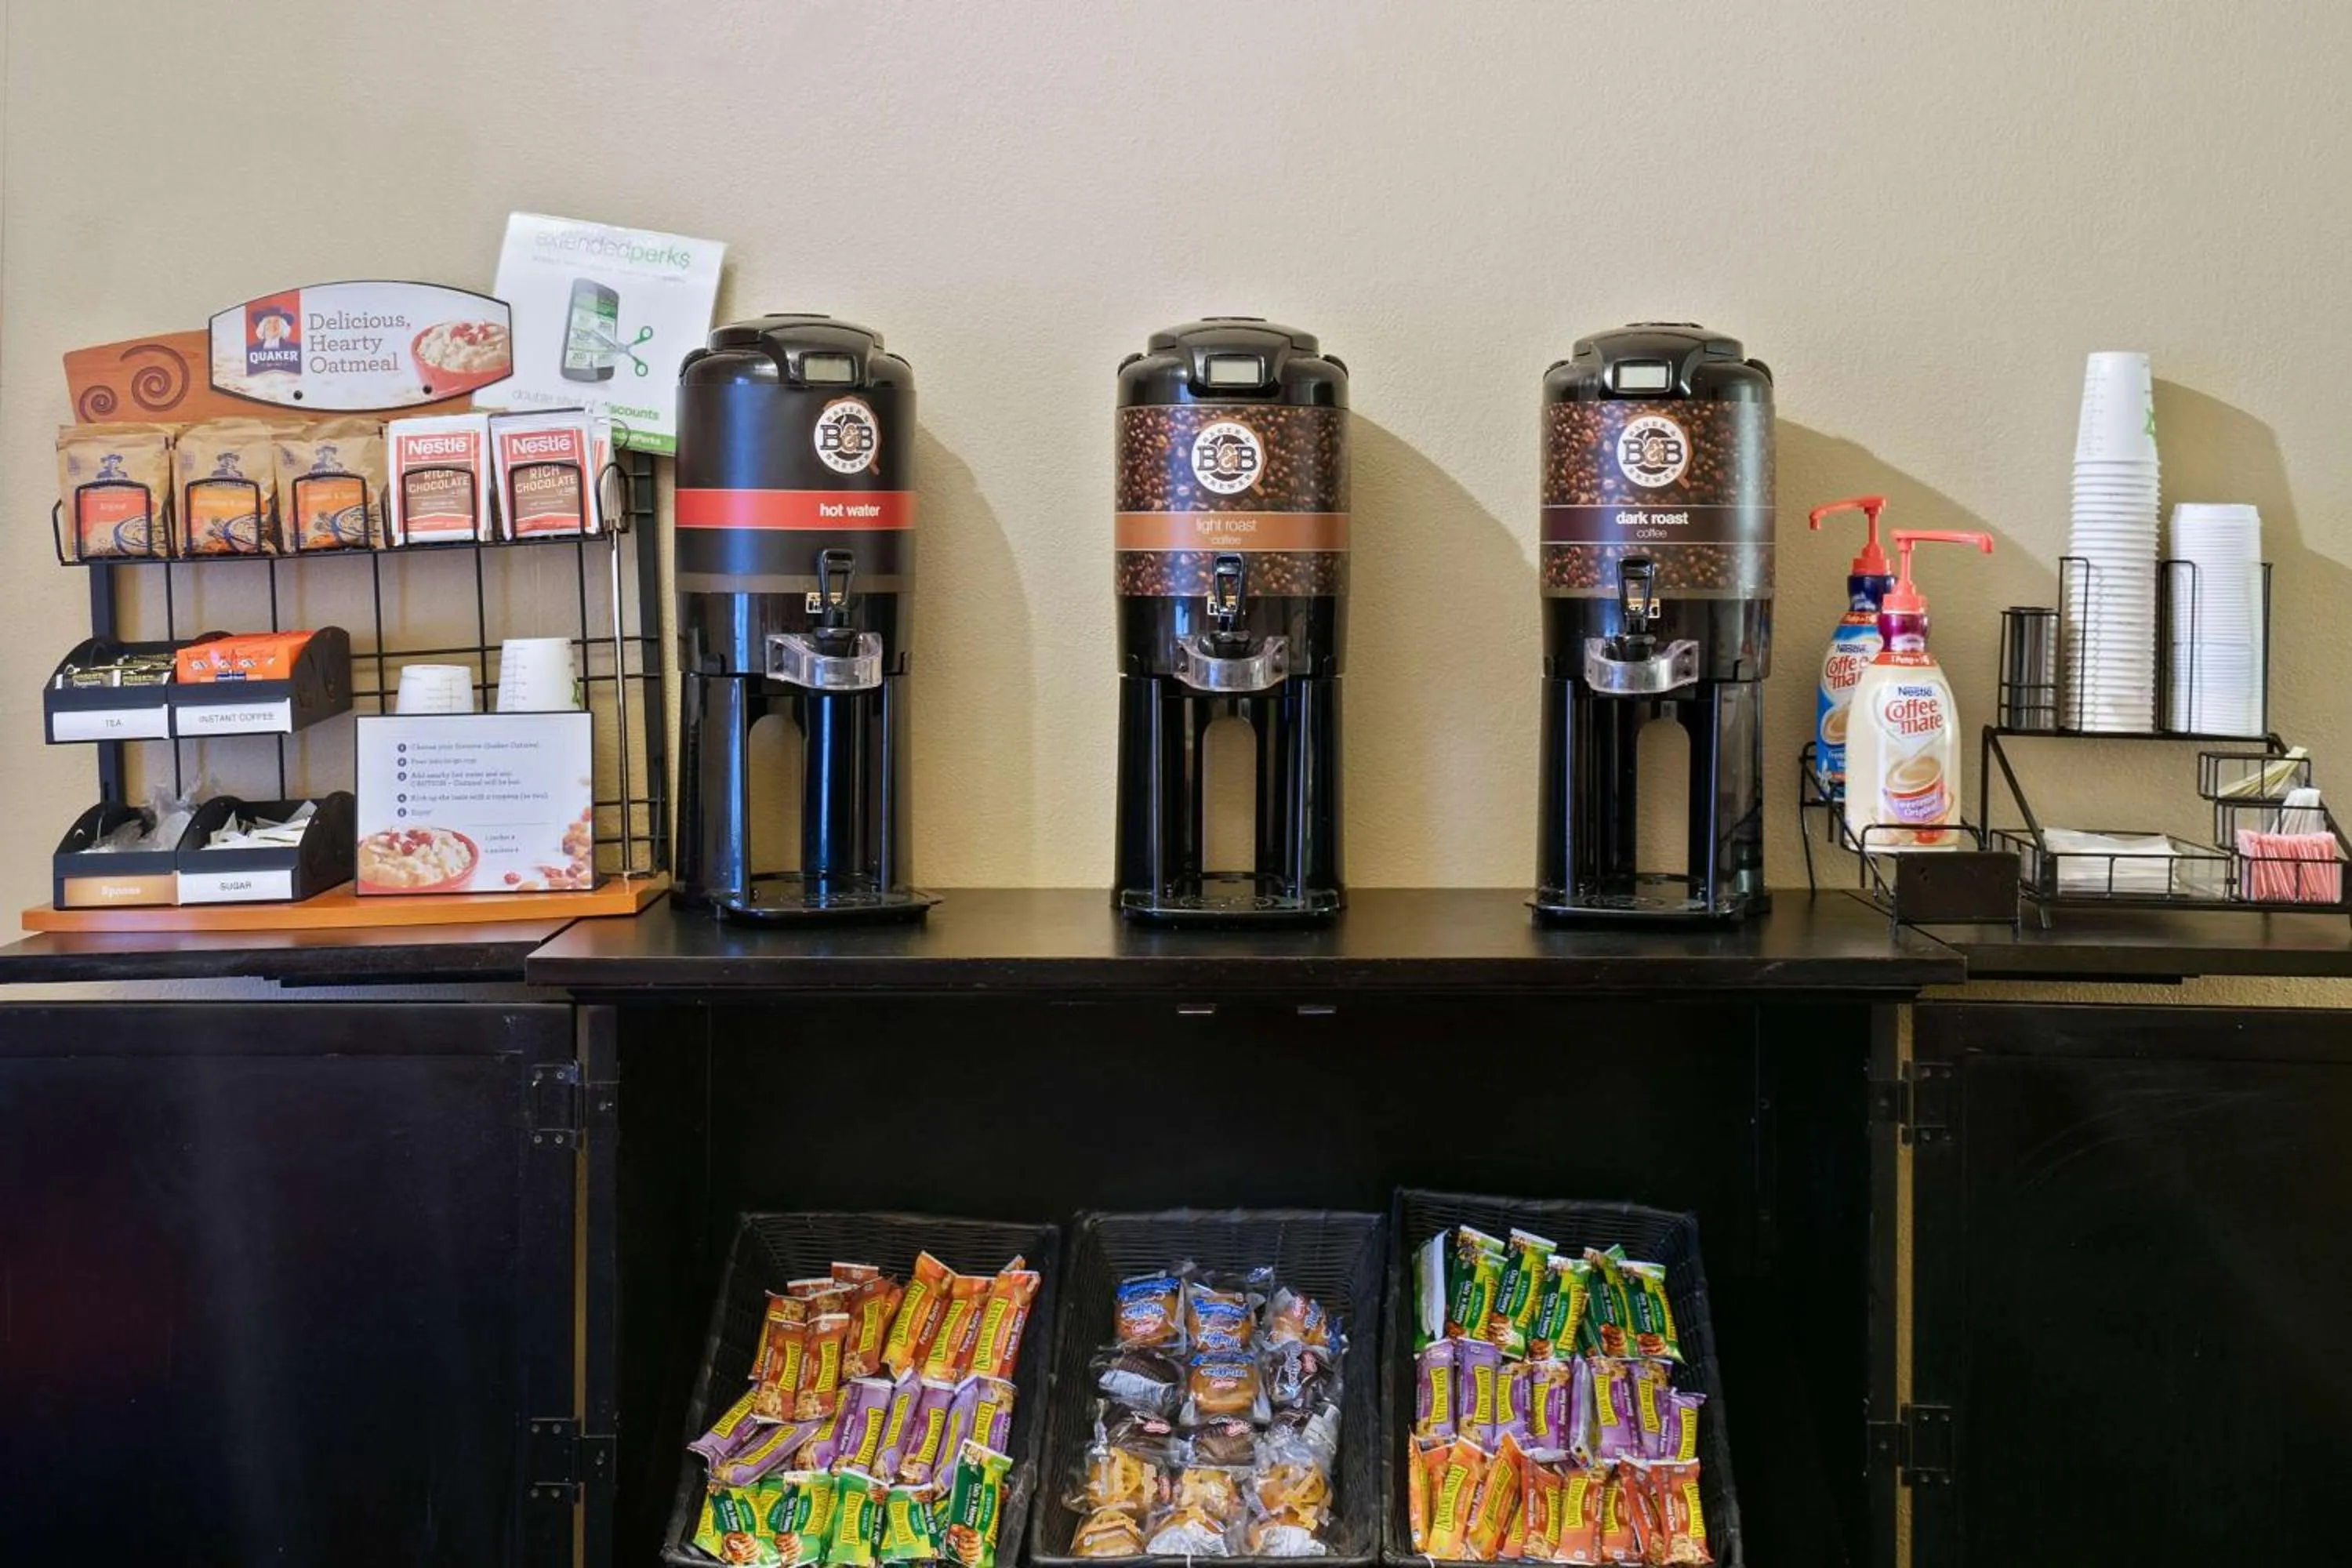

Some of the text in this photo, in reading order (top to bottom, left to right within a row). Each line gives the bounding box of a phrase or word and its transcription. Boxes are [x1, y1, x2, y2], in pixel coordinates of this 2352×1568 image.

[309, 311, 411, 331] Delicious,
[309, 335, 383, 355] Hearty
[250, 350, 298, 364] QUAKER
[309, 354, 399, 374] Oatmeal
[602, 401, 659, 419] iscounts
[530, 464, 560, 479] RICH
[408, 476, 470, 493] CHOCOLATE
[516, 476, 577, 493] CHOCOLATE
[819, 503, 880, 517] hot water
[1616, 511, 1689, 524] dark roast
[1196, 518, 1258, 534] light roast
[1636, 528, 1668, 539] coffee
[1211, 535, 1241, 545] coffee
[198, 712, 274, 723] INSTANT COFFEE
[1885, 699, 1937, 723] Coffee
[105, 719, 122, 728] TEA
[1901, 714, 1943, 735] mate
[220, 881, 252, 891] SUGAR
